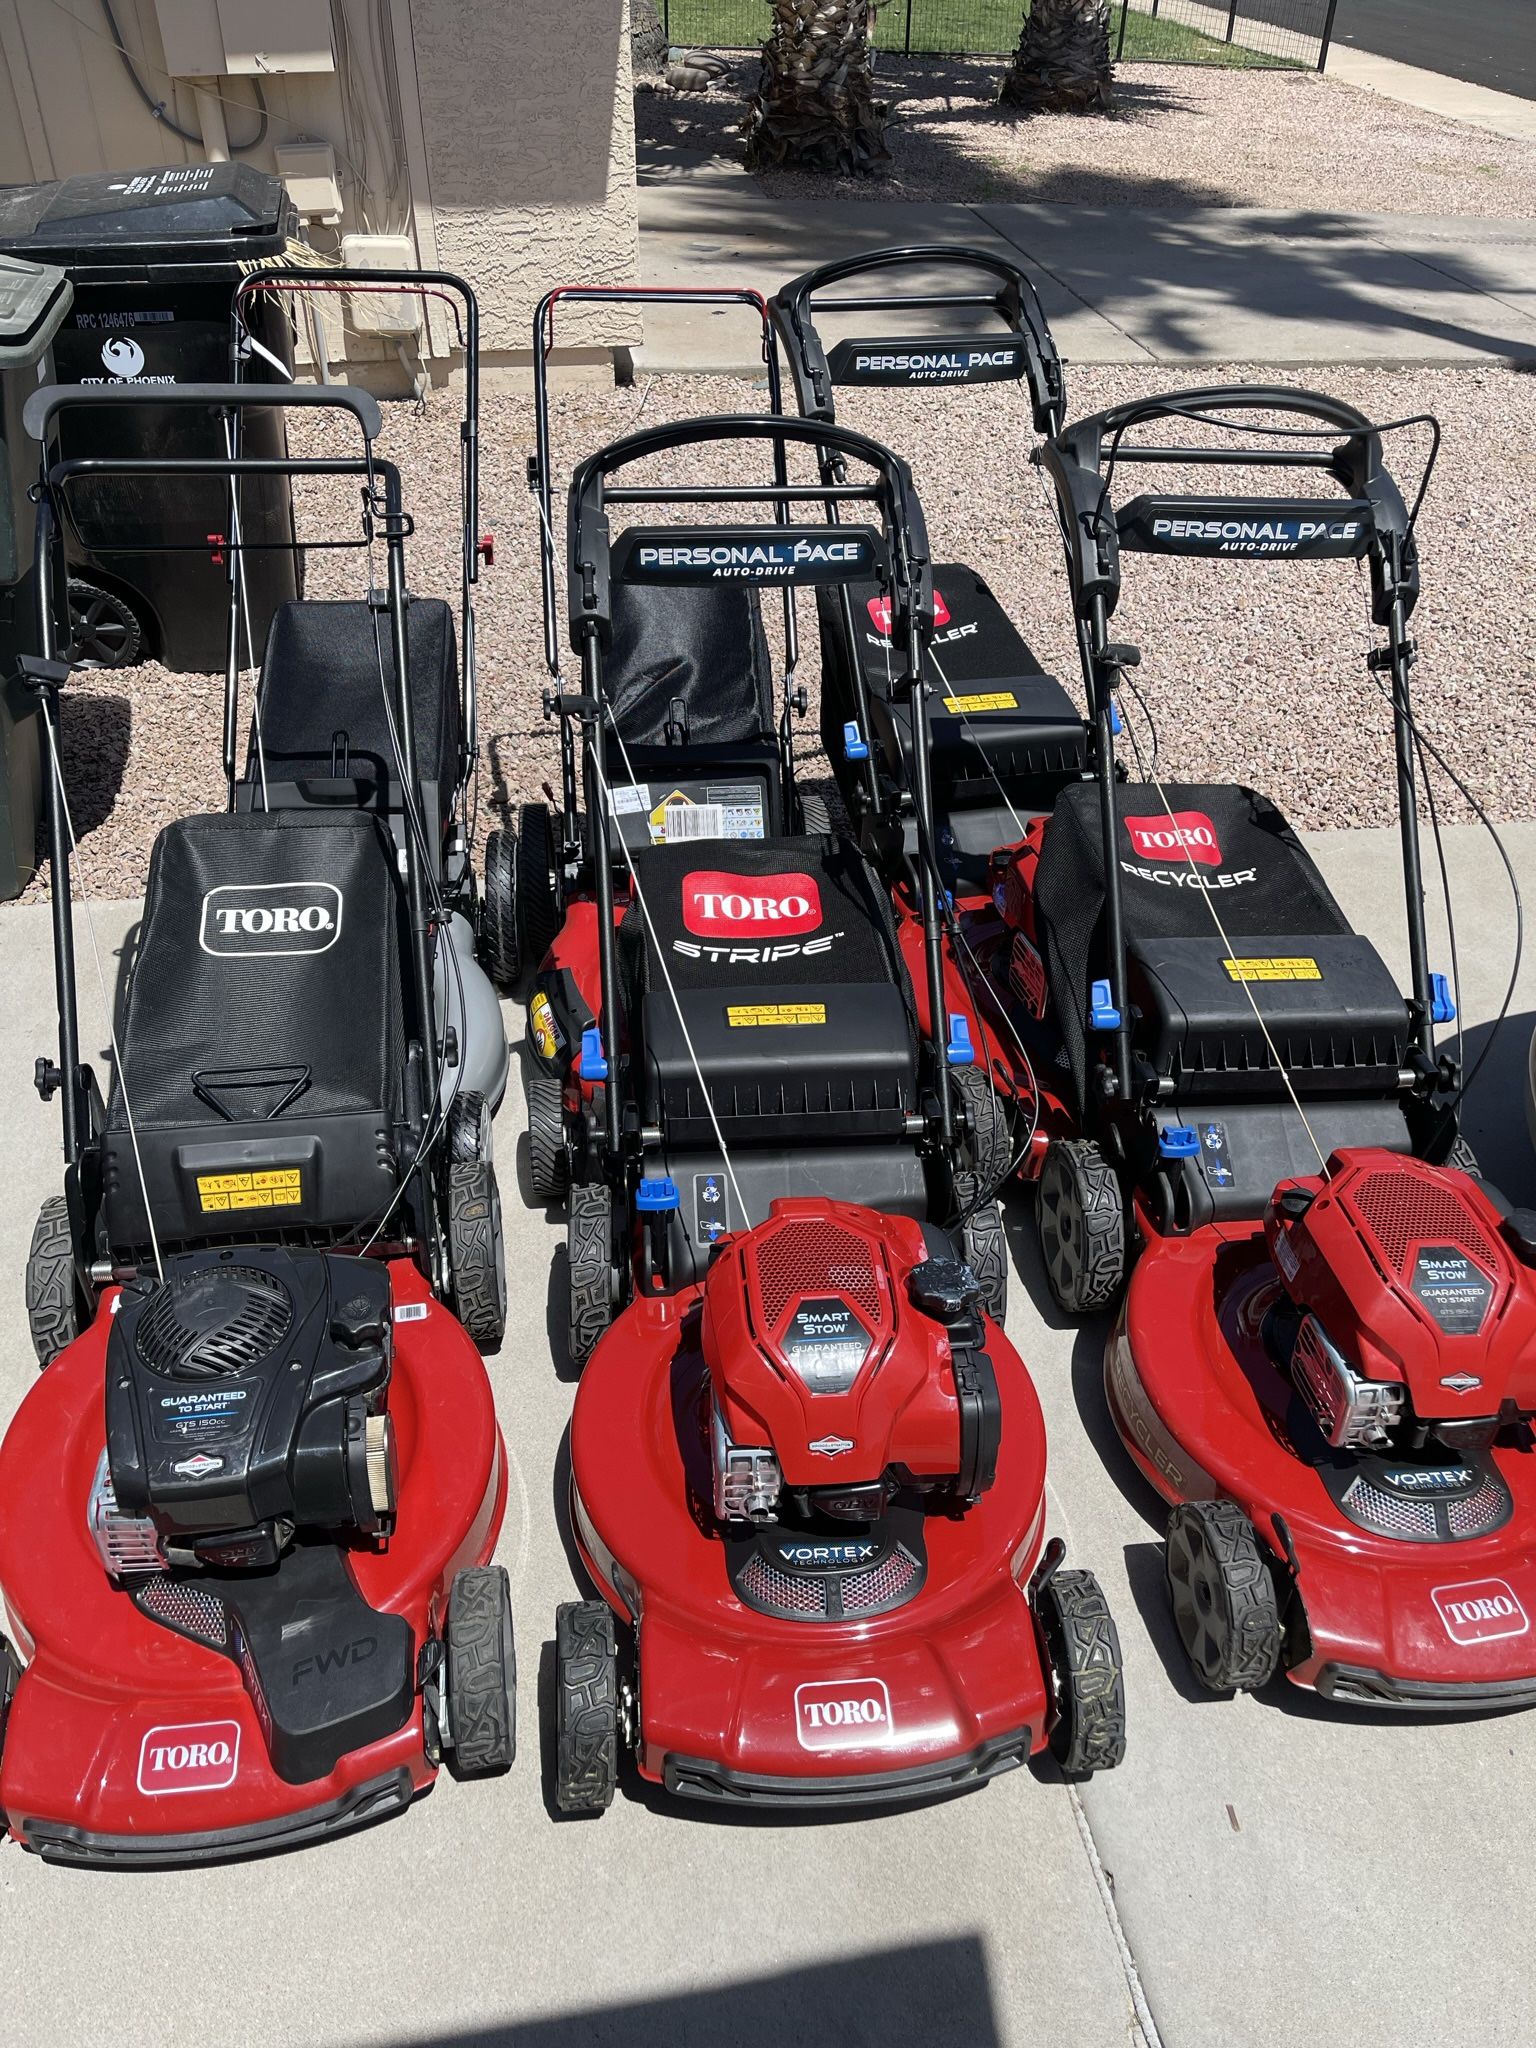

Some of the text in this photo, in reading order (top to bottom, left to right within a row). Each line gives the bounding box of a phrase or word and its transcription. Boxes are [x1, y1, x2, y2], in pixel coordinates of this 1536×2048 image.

[76, 314, 96, 328] RPC
[856, 350, 1014, 371] PERSONAL PACE
[126, 375, 176, 384] PHOENIX
[908, 369, 969, 379] AUTO-DRIVE
[1152, 519, 1358, 539] PERSONAL PACE
[639, 543, 859, 565] PERSONAL PACE
[1219, 542, 1298, 551] AUTO-DRIVE
[712, 566, 796, 577] AUTO-DRIVE
[866, 623, 978, 649] RELER
[1135, 826, 1213, 849] TORO
[1120, 861, 1256, 889] RECYCLER
[693, 893, 809, 920] TORO
[216, 906, 330, 933] TORO
[673, 936, 833, 963] STRIPE
[1421, 1288, 1484, 1297] GUARANTEED
[792, 1342, 862, 1353] GUARANTEED
[161, 1391, 247, 1407] GUARANTEED
[179, 1402, 227, 1413] TO START
[176, 1420, 197, 1429] GTS
[1384, 1470, 1472, 1486] VORTEX
[1402, 1481, 1466, 1491] TECHNOLOGY
[779, 1545, 874, 1560] VORTEX
[793, 1557, 865, 1566] TECHNOLOGY
[1444, 1595, 1514, 1625] TORO
[292, 1636, 378, 1687] FWD
[803, 1698, 882, 1728] TORO
[149, 1741, 230, 1772] TORO
